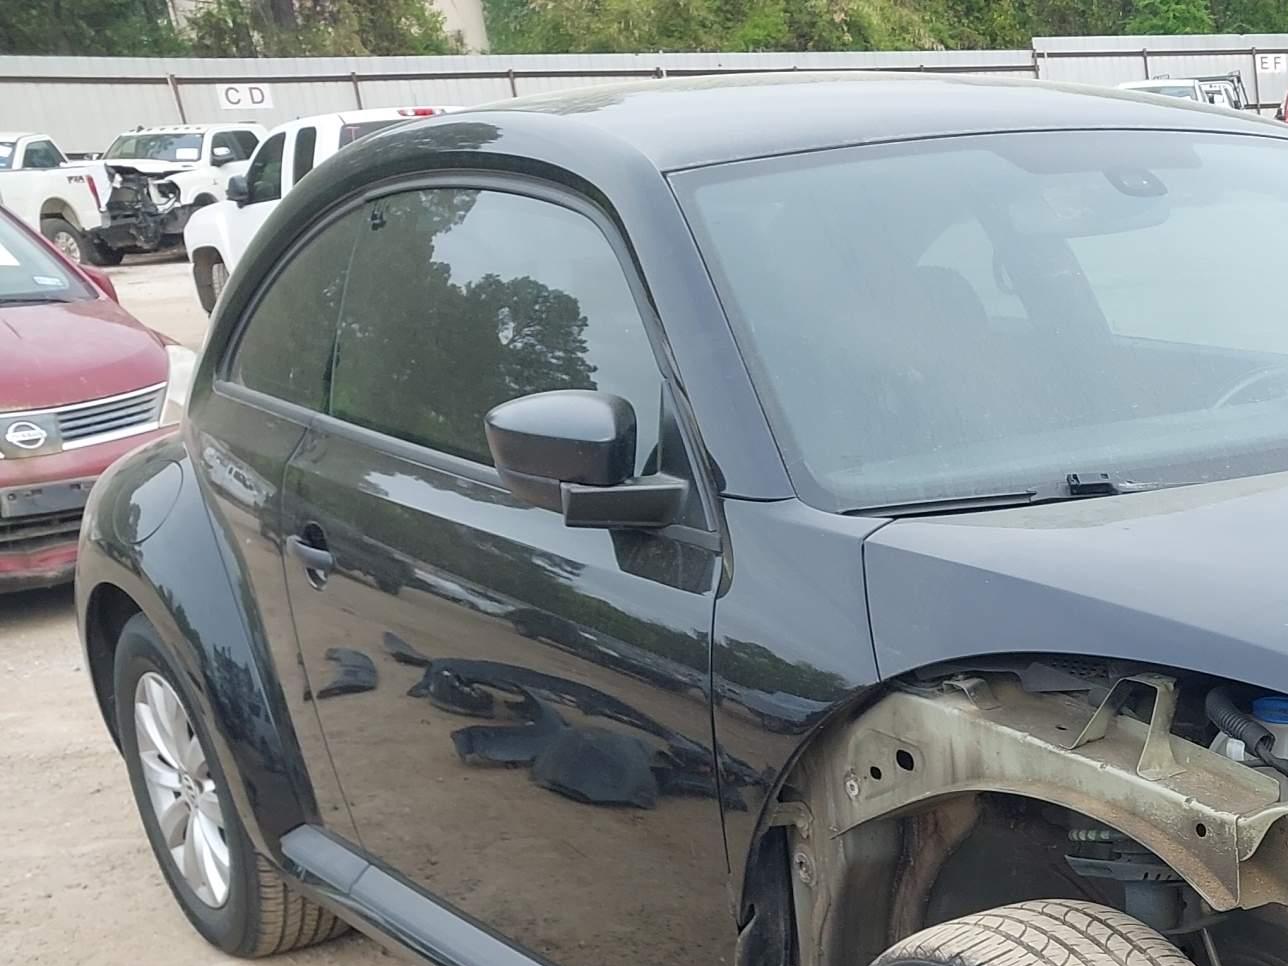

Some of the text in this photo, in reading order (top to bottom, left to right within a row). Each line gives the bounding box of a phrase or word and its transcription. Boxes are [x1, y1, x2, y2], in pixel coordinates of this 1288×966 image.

[1260, 56, 1281, 70] E F
[225, 86, 265, 105] C D
